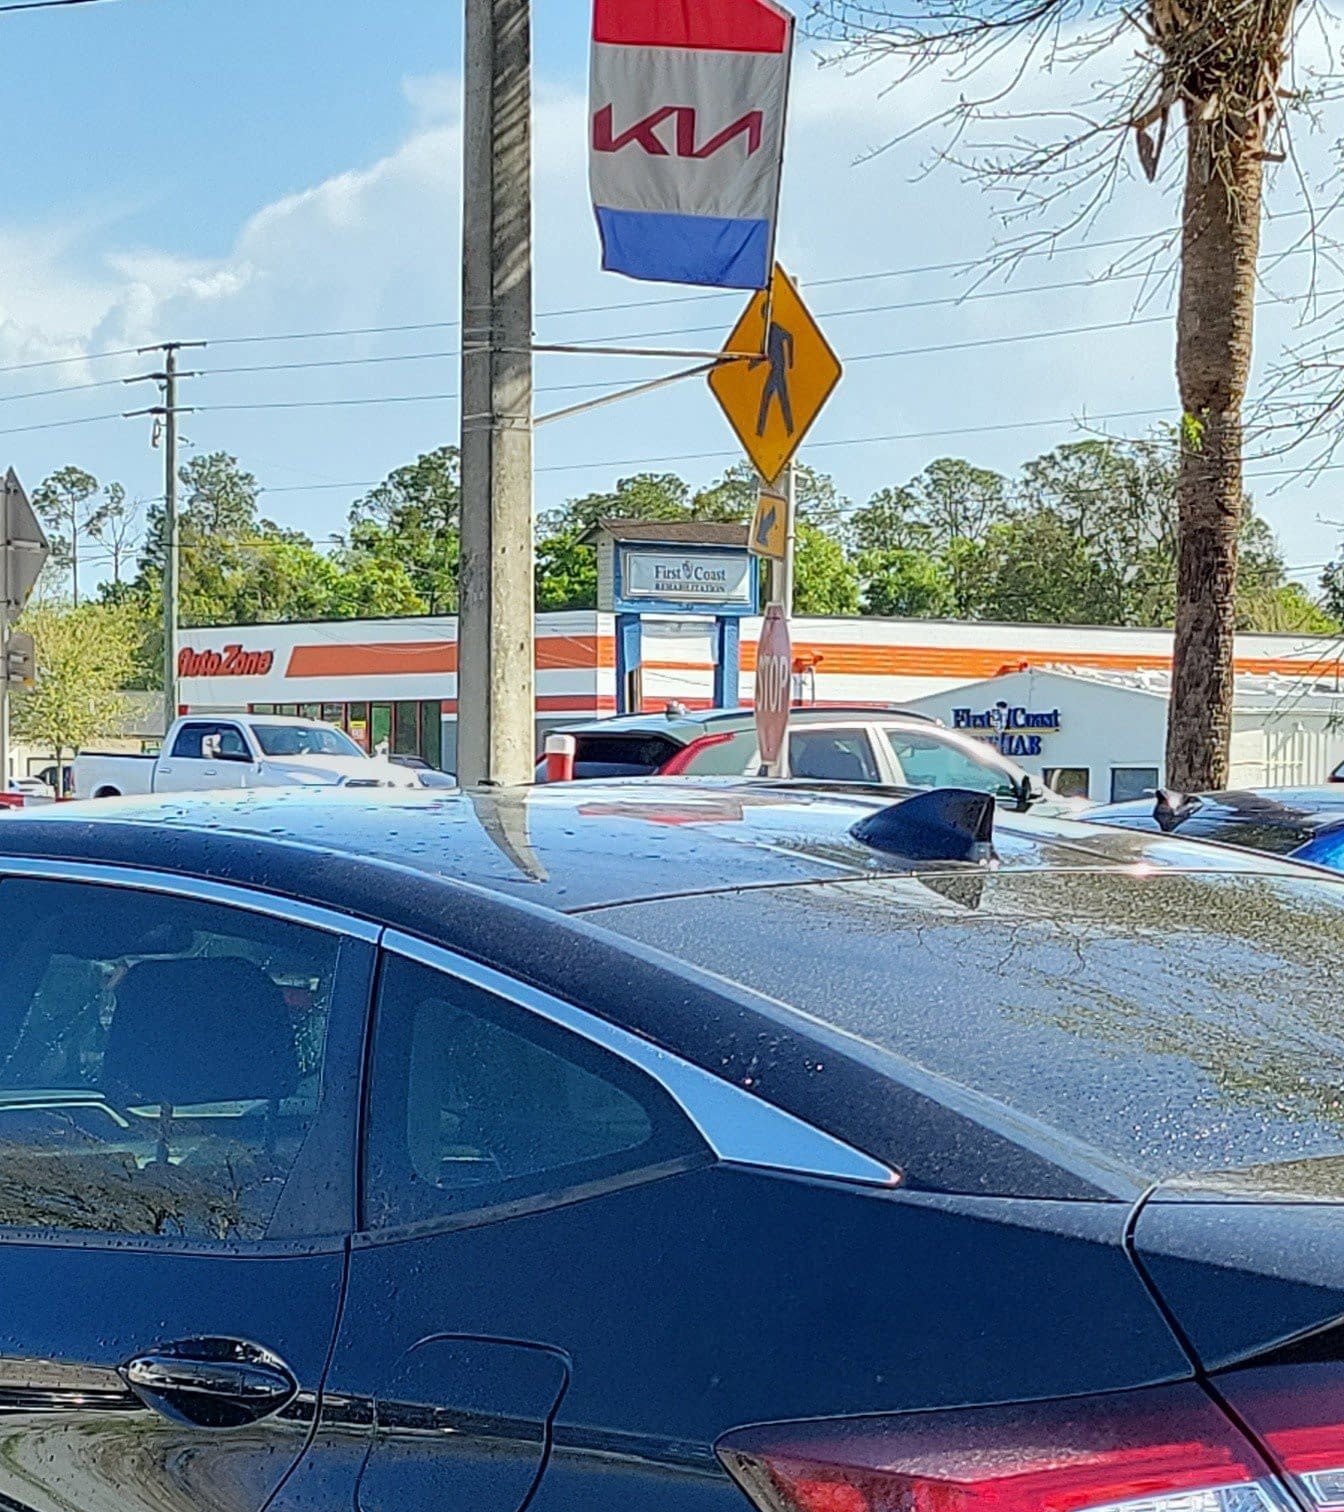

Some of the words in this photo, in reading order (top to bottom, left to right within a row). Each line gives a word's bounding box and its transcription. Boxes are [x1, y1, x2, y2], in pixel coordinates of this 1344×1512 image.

[593, 103, 763, 159] KIA
[654, 565, 681, 580] First
[694, 566, 726, 581] Coast
[177, 644, 275, 678] AutoZone
[757, 656, 789, 713] STOP
[1011, 707, 1062, 728] Coast
